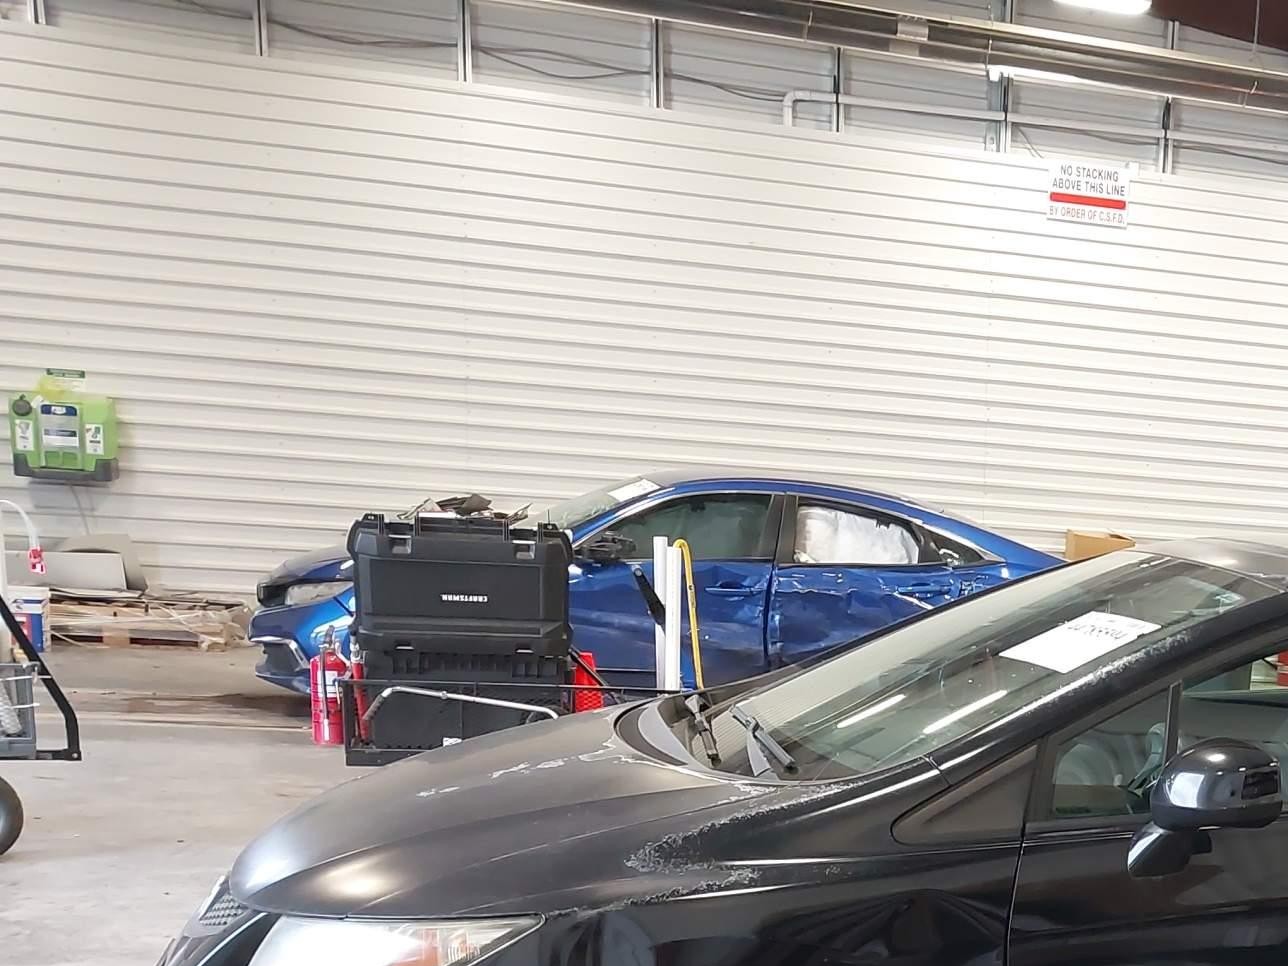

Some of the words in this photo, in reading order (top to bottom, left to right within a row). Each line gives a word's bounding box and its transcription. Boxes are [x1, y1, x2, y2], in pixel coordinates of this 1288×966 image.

[1060, 164, 1073, 177] NO
[1076, 166, 1119, 181] STACKING
[1052, 177, 1082, 191] ABOVE
[1085, 181, 1104, 194] THIS
[1106, 183, 1126, 197] LINE
[1049, 205, 1059, 216] BY
[1060, 206, 1086, 220] ORDER
[1087, 209, 1097, 221] OF
